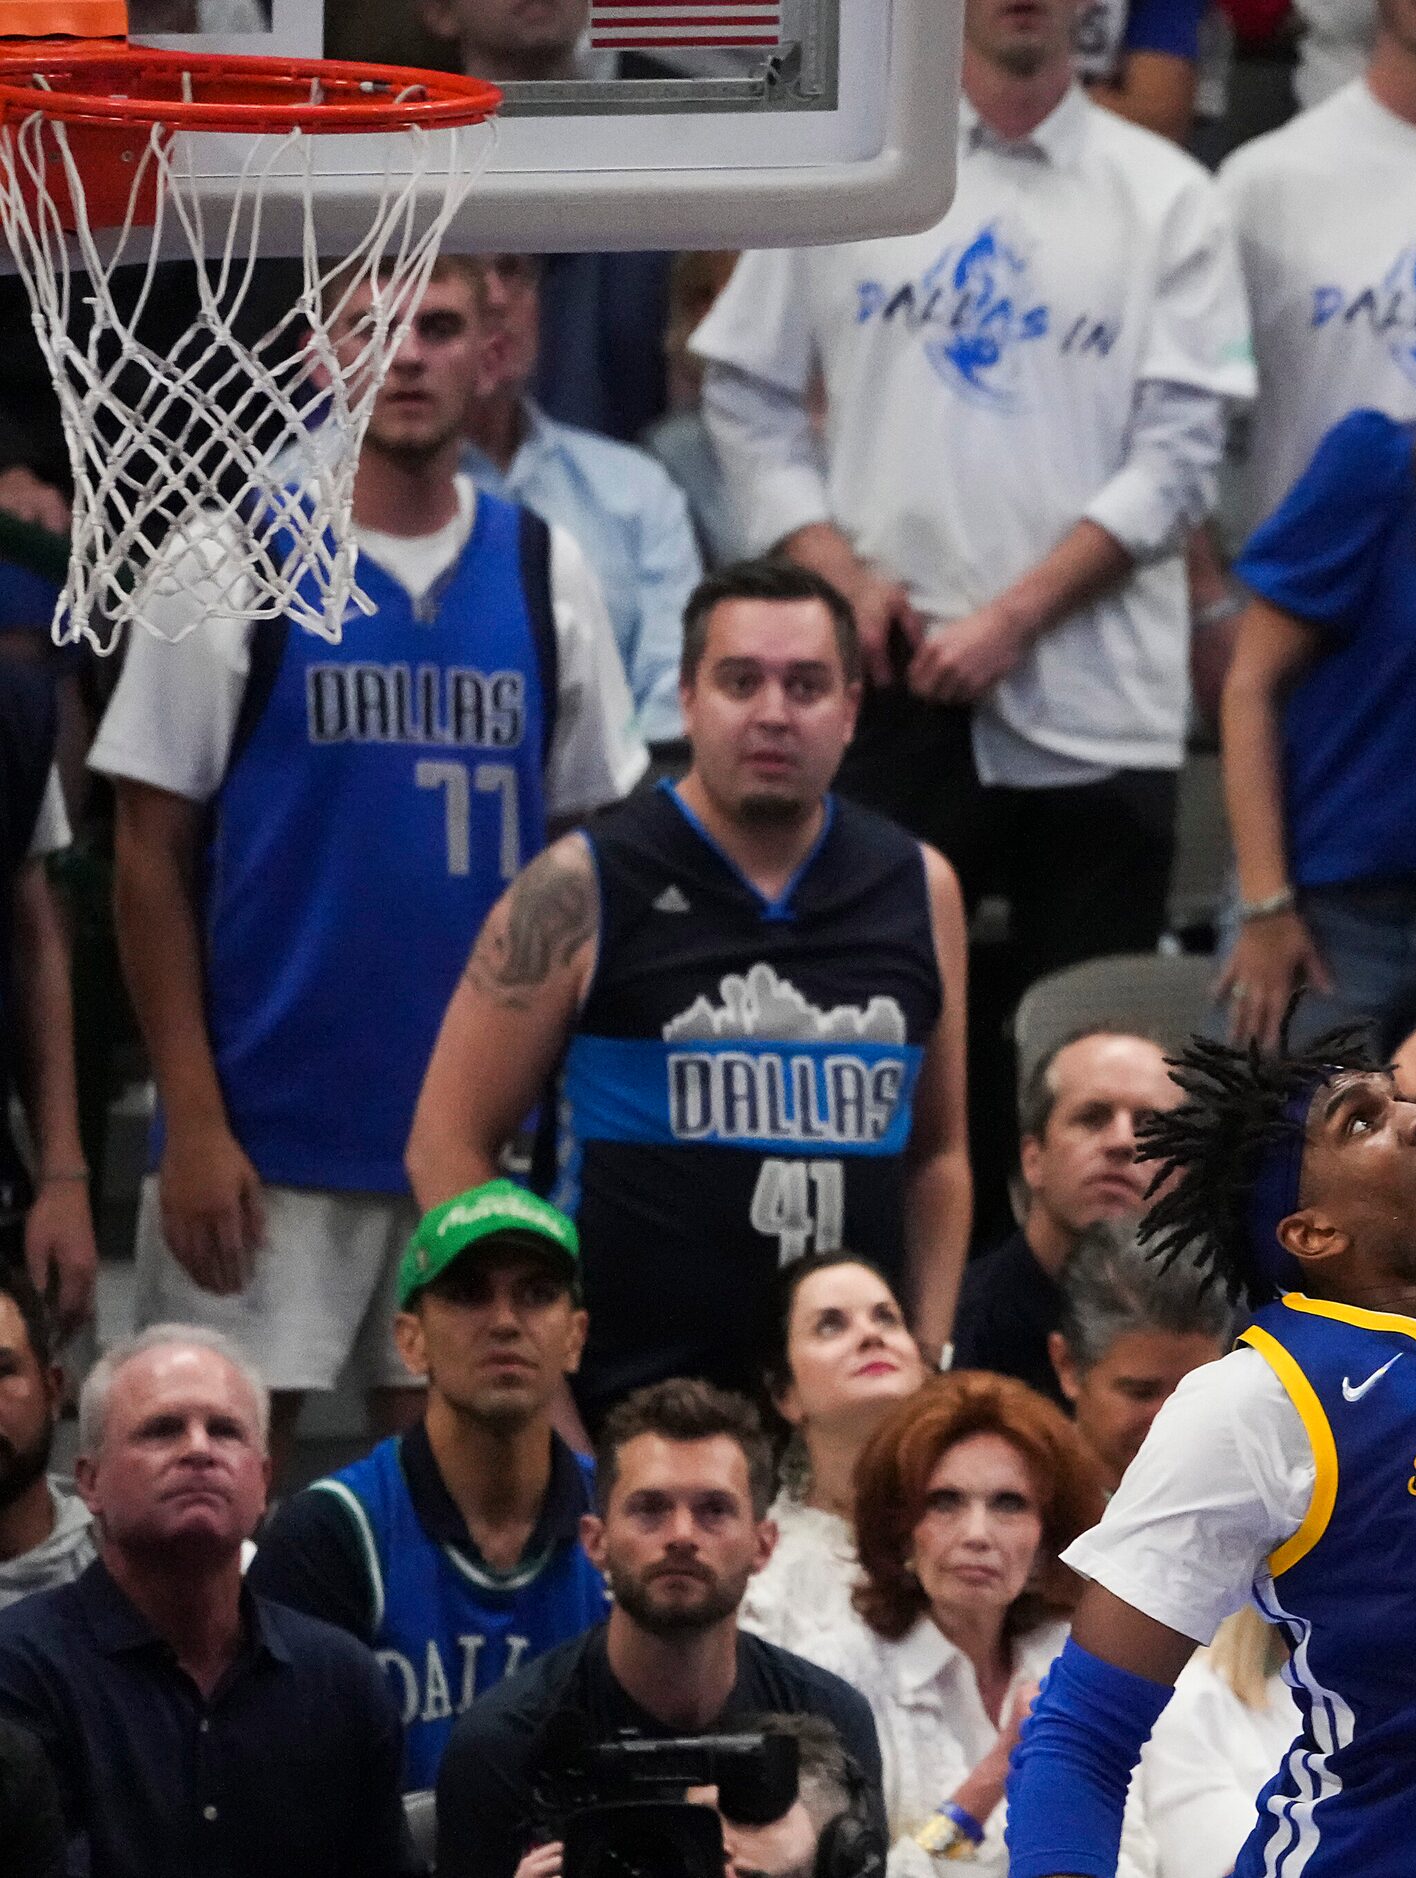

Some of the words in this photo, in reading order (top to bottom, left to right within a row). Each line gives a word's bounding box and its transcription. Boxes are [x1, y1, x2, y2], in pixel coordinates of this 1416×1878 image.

[307, 661, 525, 749] DALLAS
[415, 761, 521, 878] 77
[667, 1050, 905, 1144] DALLAS
[750, 1158, 845, 1268] 41
